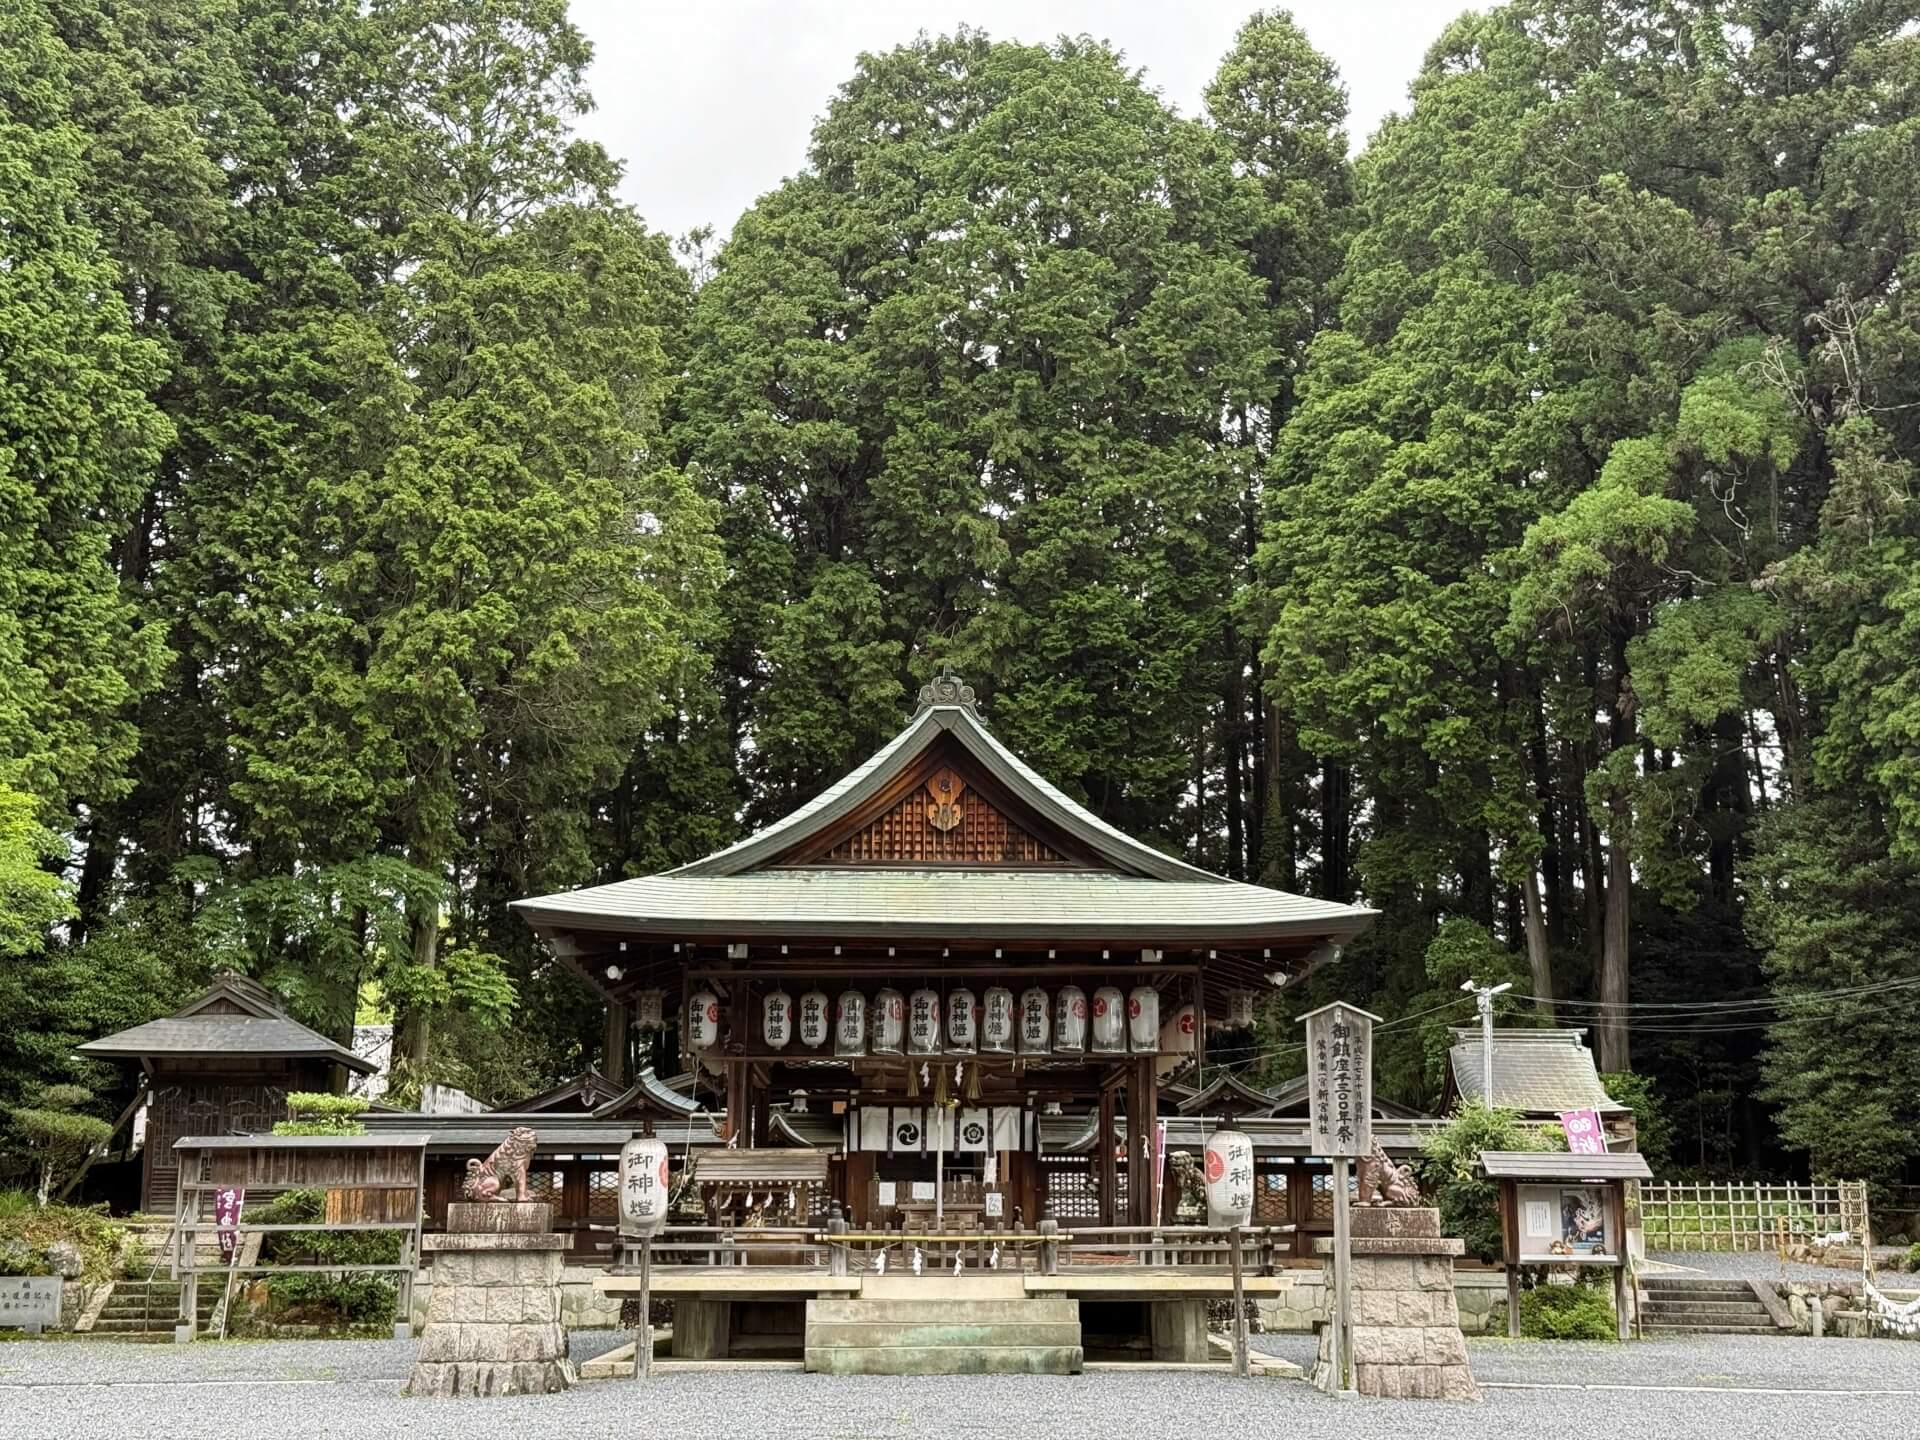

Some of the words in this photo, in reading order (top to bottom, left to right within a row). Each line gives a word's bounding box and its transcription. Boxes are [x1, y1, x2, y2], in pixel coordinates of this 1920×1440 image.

[768, 998, 784, 1039] 御神燈
[803, 998, 819, 1038] 御神燈
[913, 997, 929, 1037] 御神燈
[952, 997, 968, 1037] 御神燈
[988, 995, 1004, 1035] 御神燈
[1026, 1000, 1041, 1040] 御神燈
[628, 1152, 654, 1217] 御神燈
[1228, 1144, 1252, 1209] 御神燈
